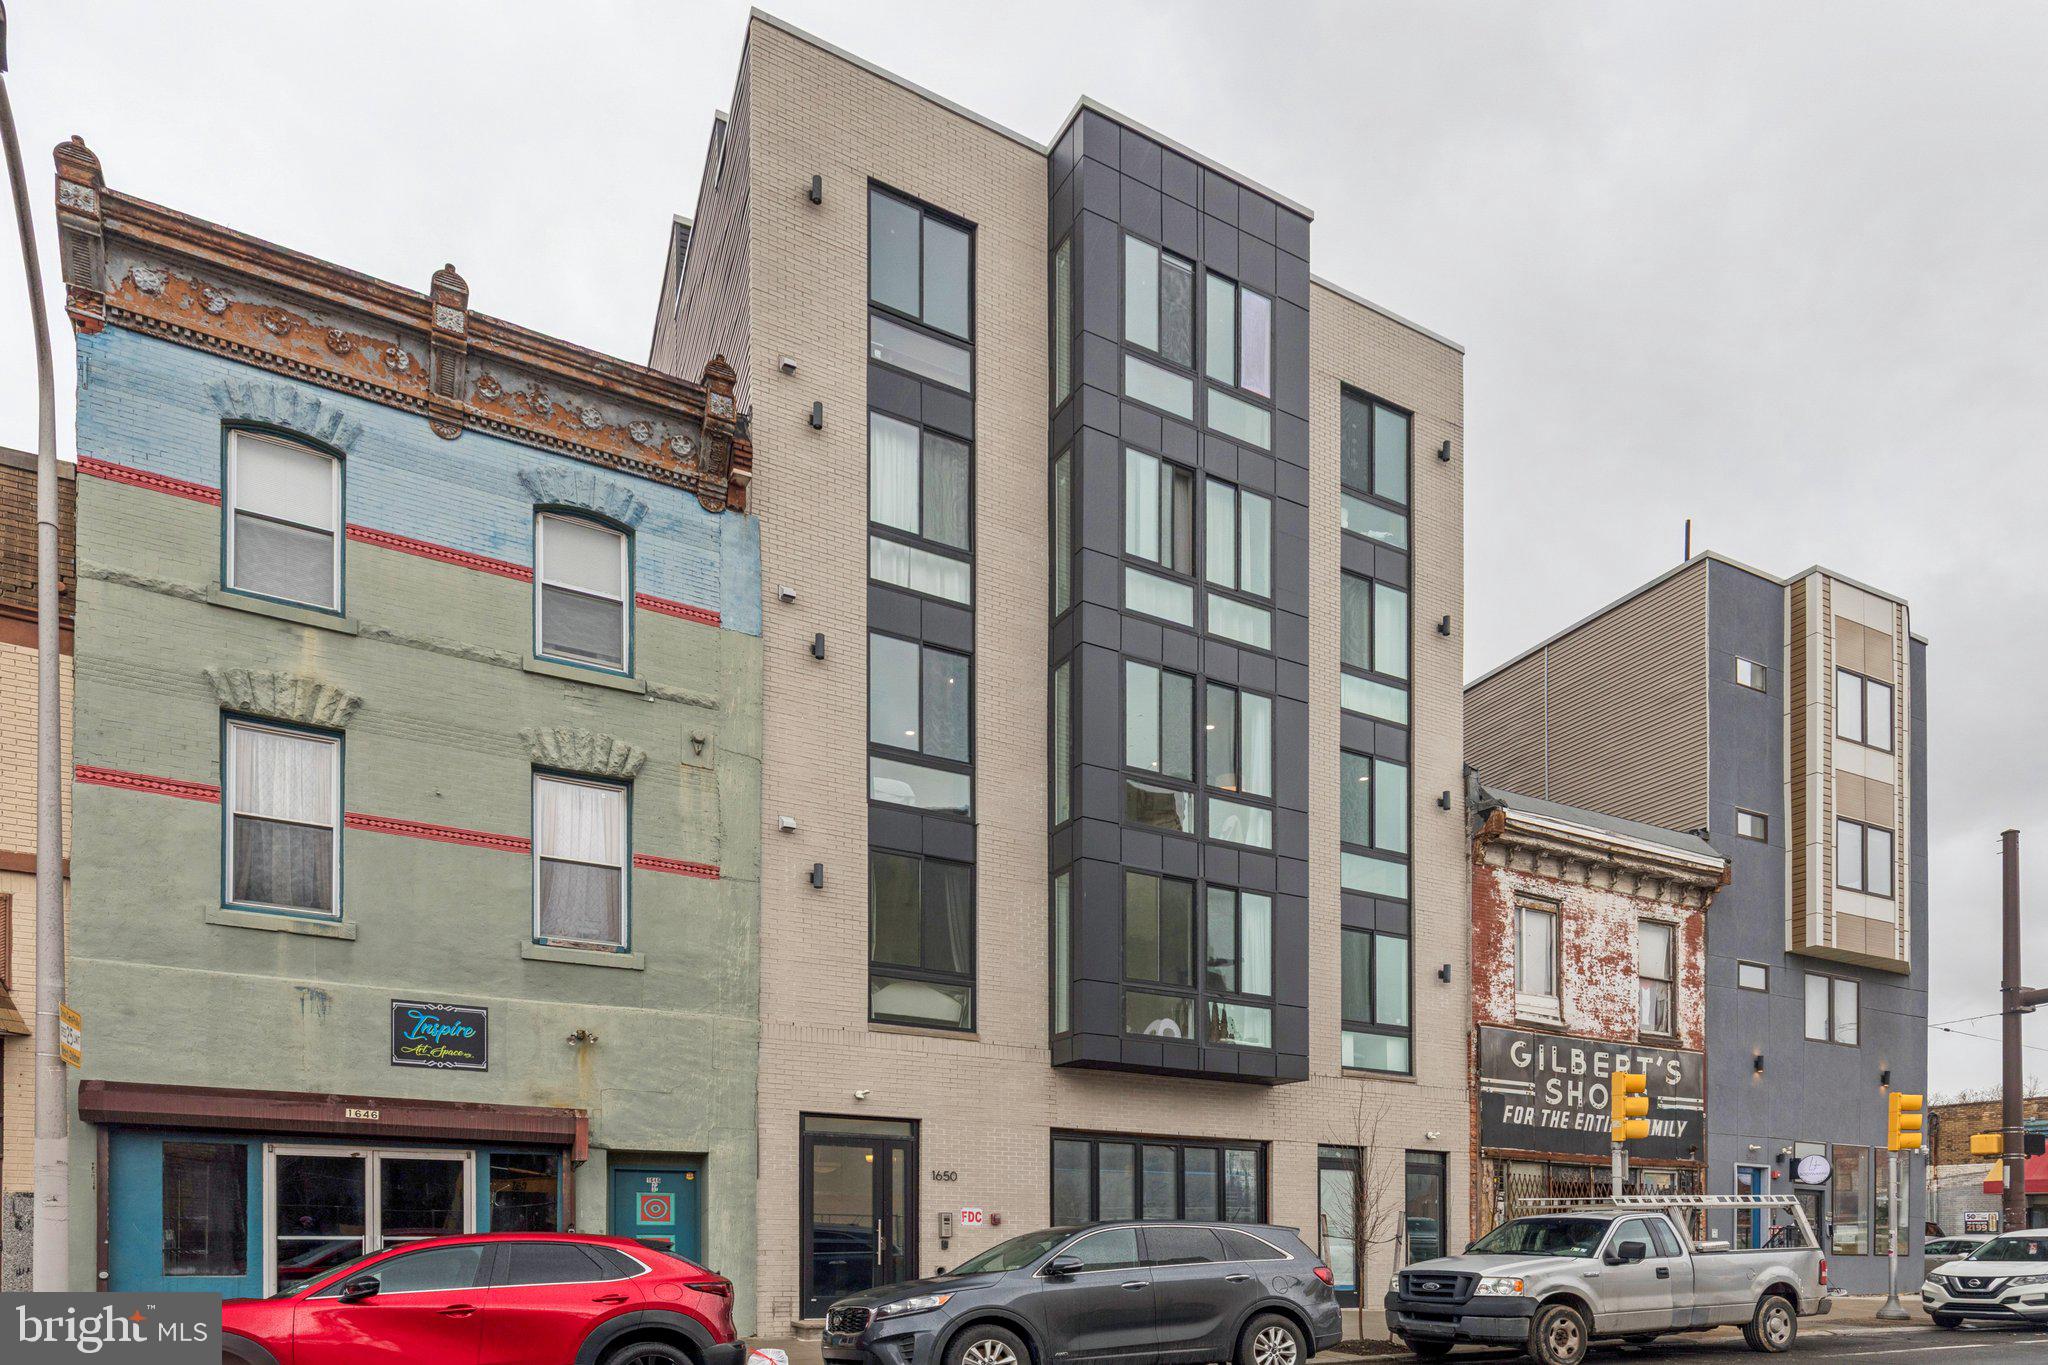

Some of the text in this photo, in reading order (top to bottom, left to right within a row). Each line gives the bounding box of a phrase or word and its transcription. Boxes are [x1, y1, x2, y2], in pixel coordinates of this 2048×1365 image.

[403, 1009, 476, 1044] Inspire
[400, 1044, 431, 1057] Art
[430, 1046, 464, 1058] Space
[1510, 1041, 1681, 1086] GILBERT'S
[348, 1109, 378, 1119] 1646
[1503, 1105, 1688, 1137] FOR THE ENTI MILY
[932, 1170, 957, 1182] 1650
[961, 1211, 982, 1223] FDC
